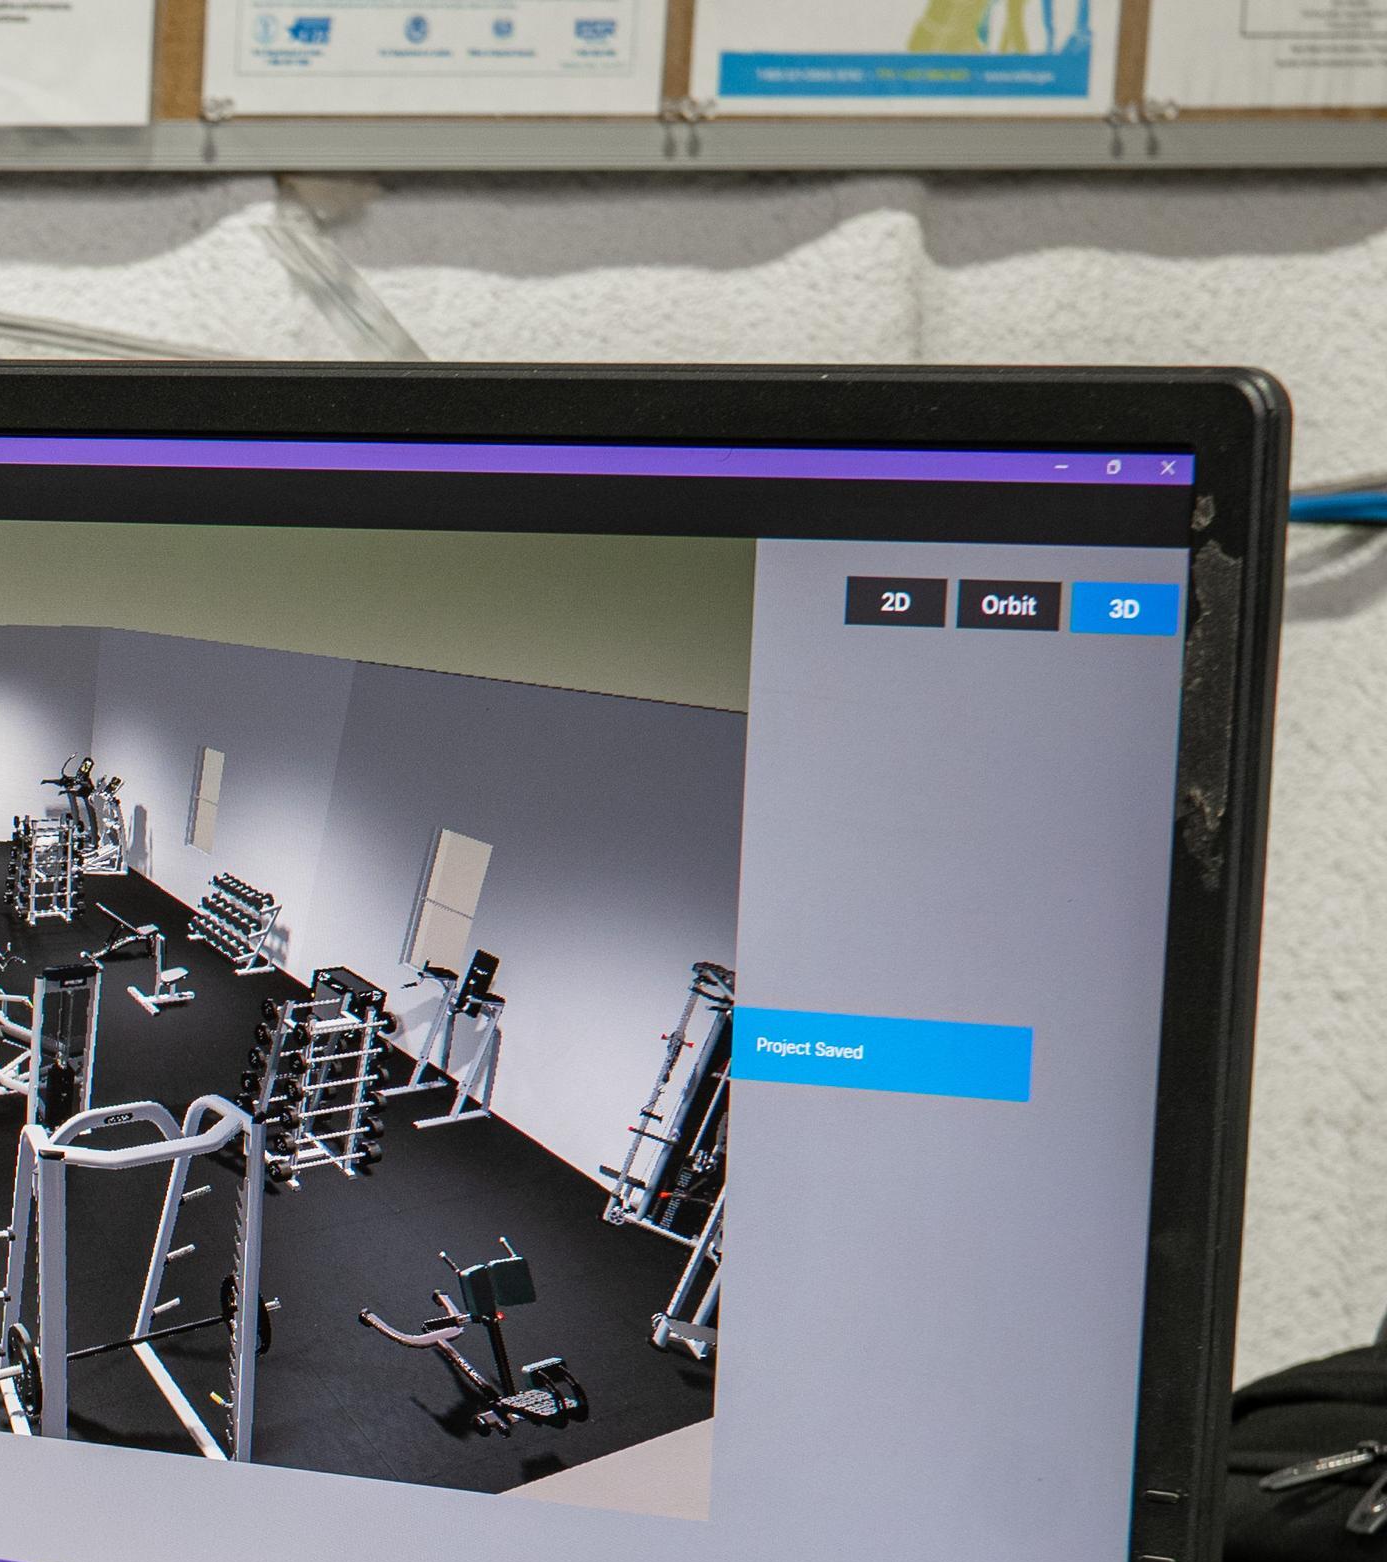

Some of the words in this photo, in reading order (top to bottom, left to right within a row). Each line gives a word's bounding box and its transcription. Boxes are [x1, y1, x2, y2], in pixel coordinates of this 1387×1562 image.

[881, 592, 910, 612] 2D
[982, 595, 1036, 616] Orbit
[1109, 599, 1139, 619] 3D
[757, 1037, 810, 1056] Project
[815, 1042, 863, 1060] Saved
